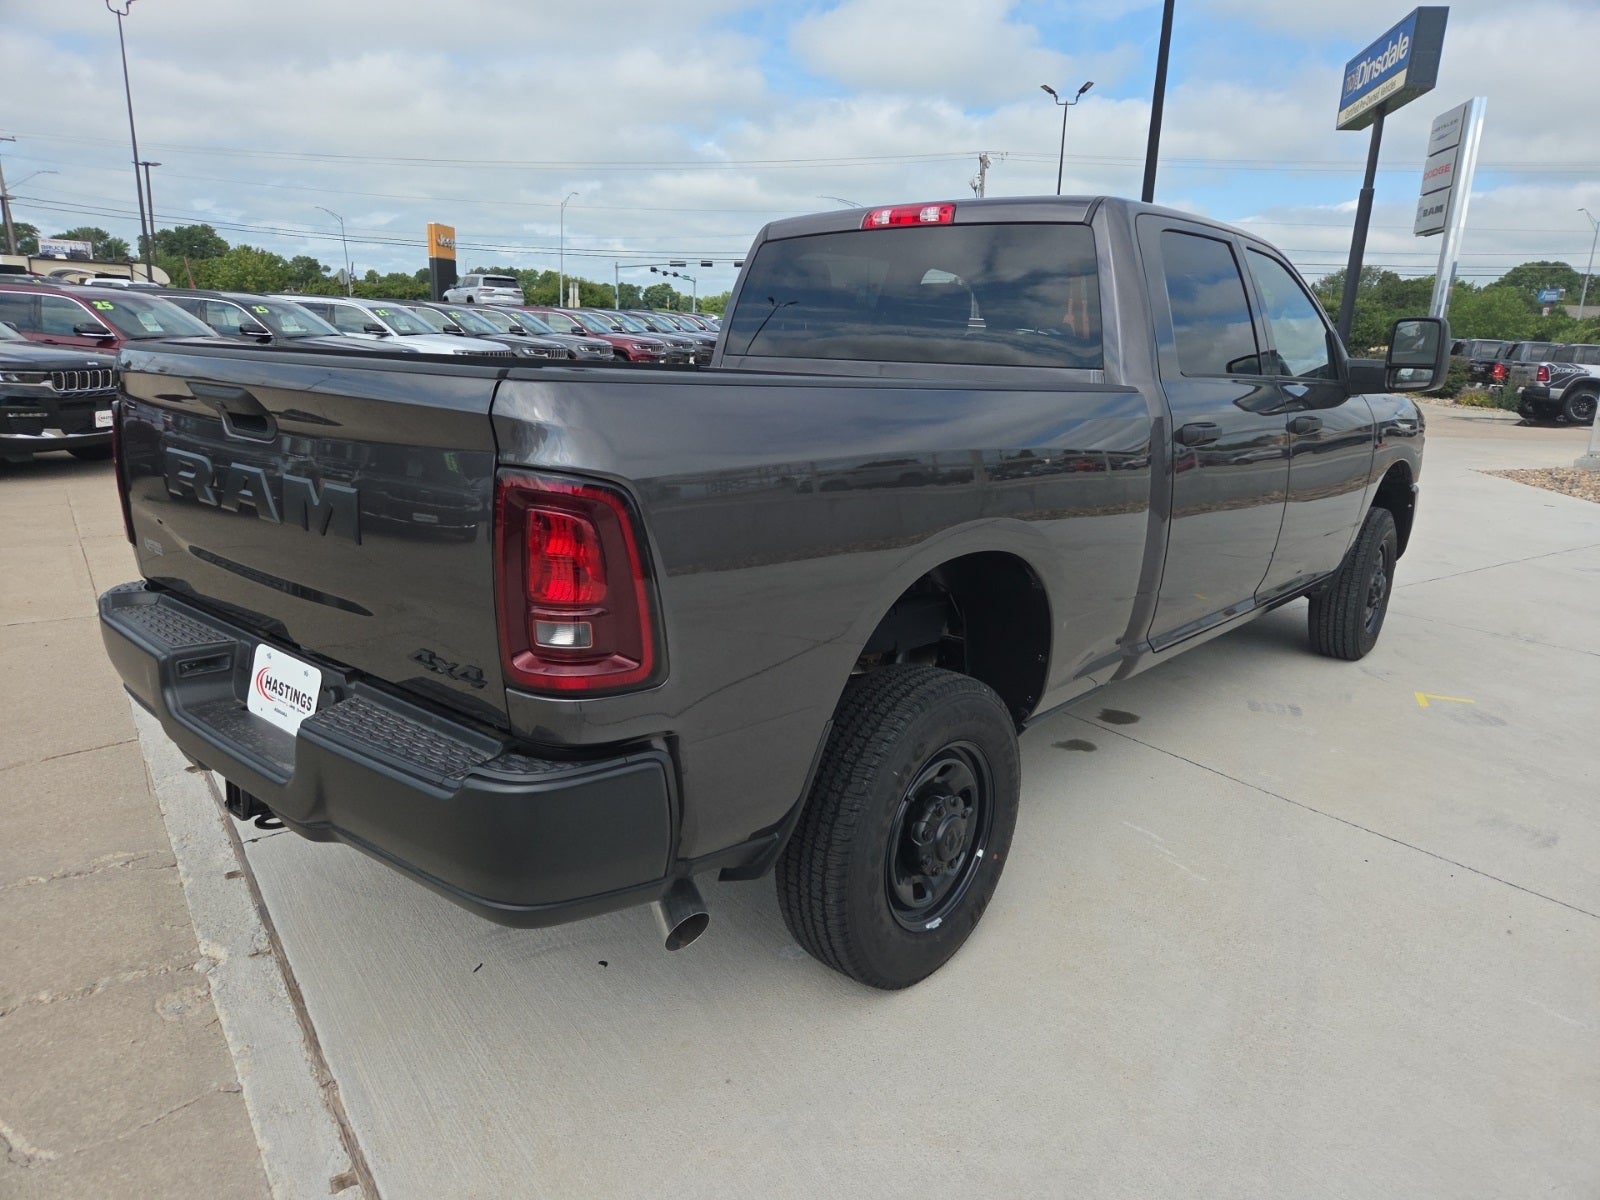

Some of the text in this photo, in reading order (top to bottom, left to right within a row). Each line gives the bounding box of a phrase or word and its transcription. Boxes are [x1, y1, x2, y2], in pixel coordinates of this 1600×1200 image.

[1356, 32, 1410, 91] Dinsdale
[1424, 163, 1452, 181] DODGE
[1422, 204, 1444, 218] RAM
[92, 300, 115, 310] 25
[251, 305, 270, 314] 25
[165, 446, 362, 546] RAM
[264, 674, 313, 712] HASTINGS
